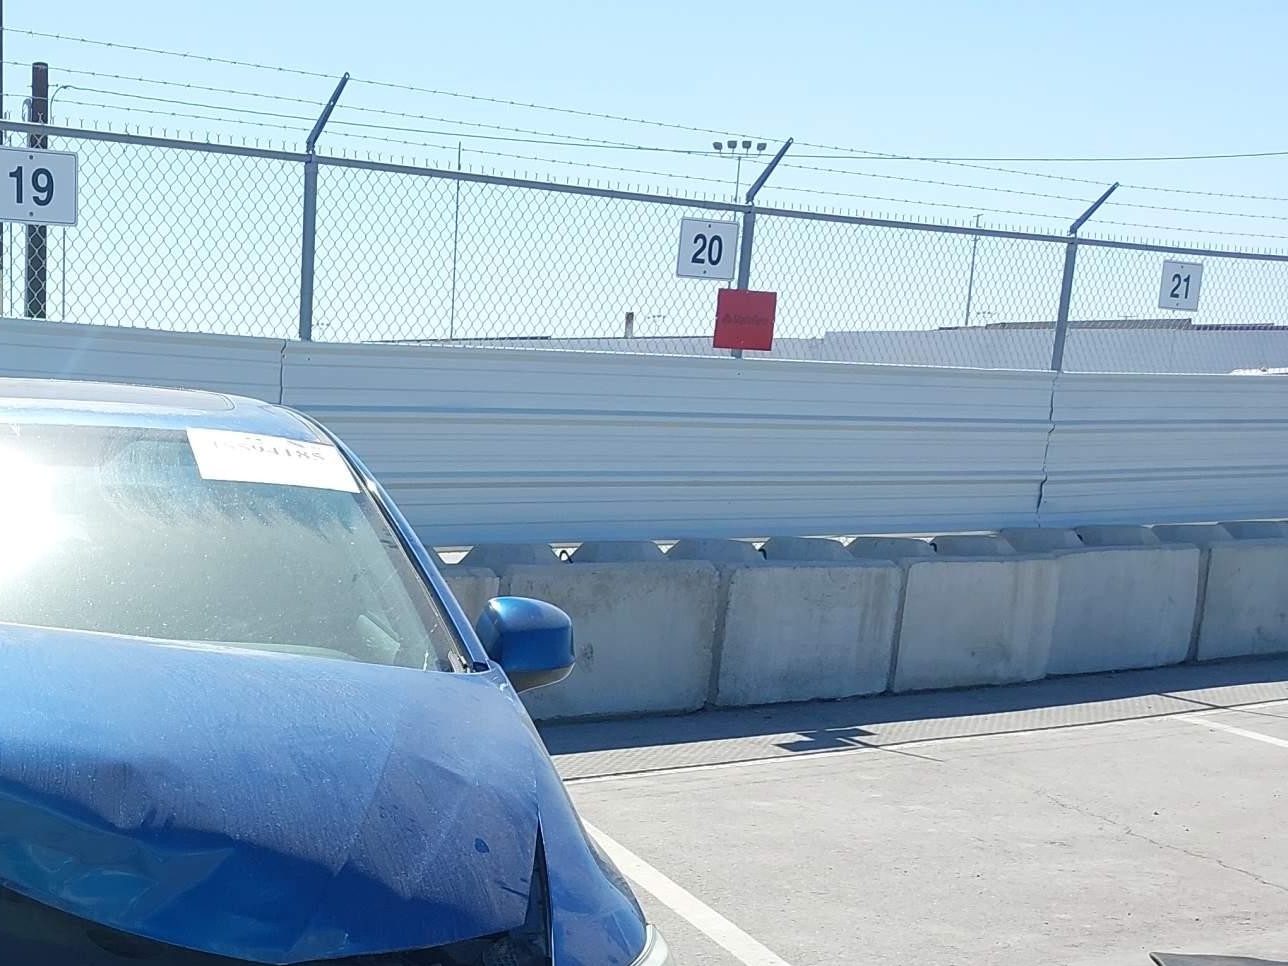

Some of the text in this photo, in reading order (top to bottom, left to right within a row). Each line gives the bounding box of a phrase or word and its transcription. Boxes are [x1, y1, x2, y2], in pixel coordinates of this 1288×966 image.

[9, 165, 54, 207] 19
[690, 233, 723, 266] 20
[1169, 273, 1191, 299] 21
